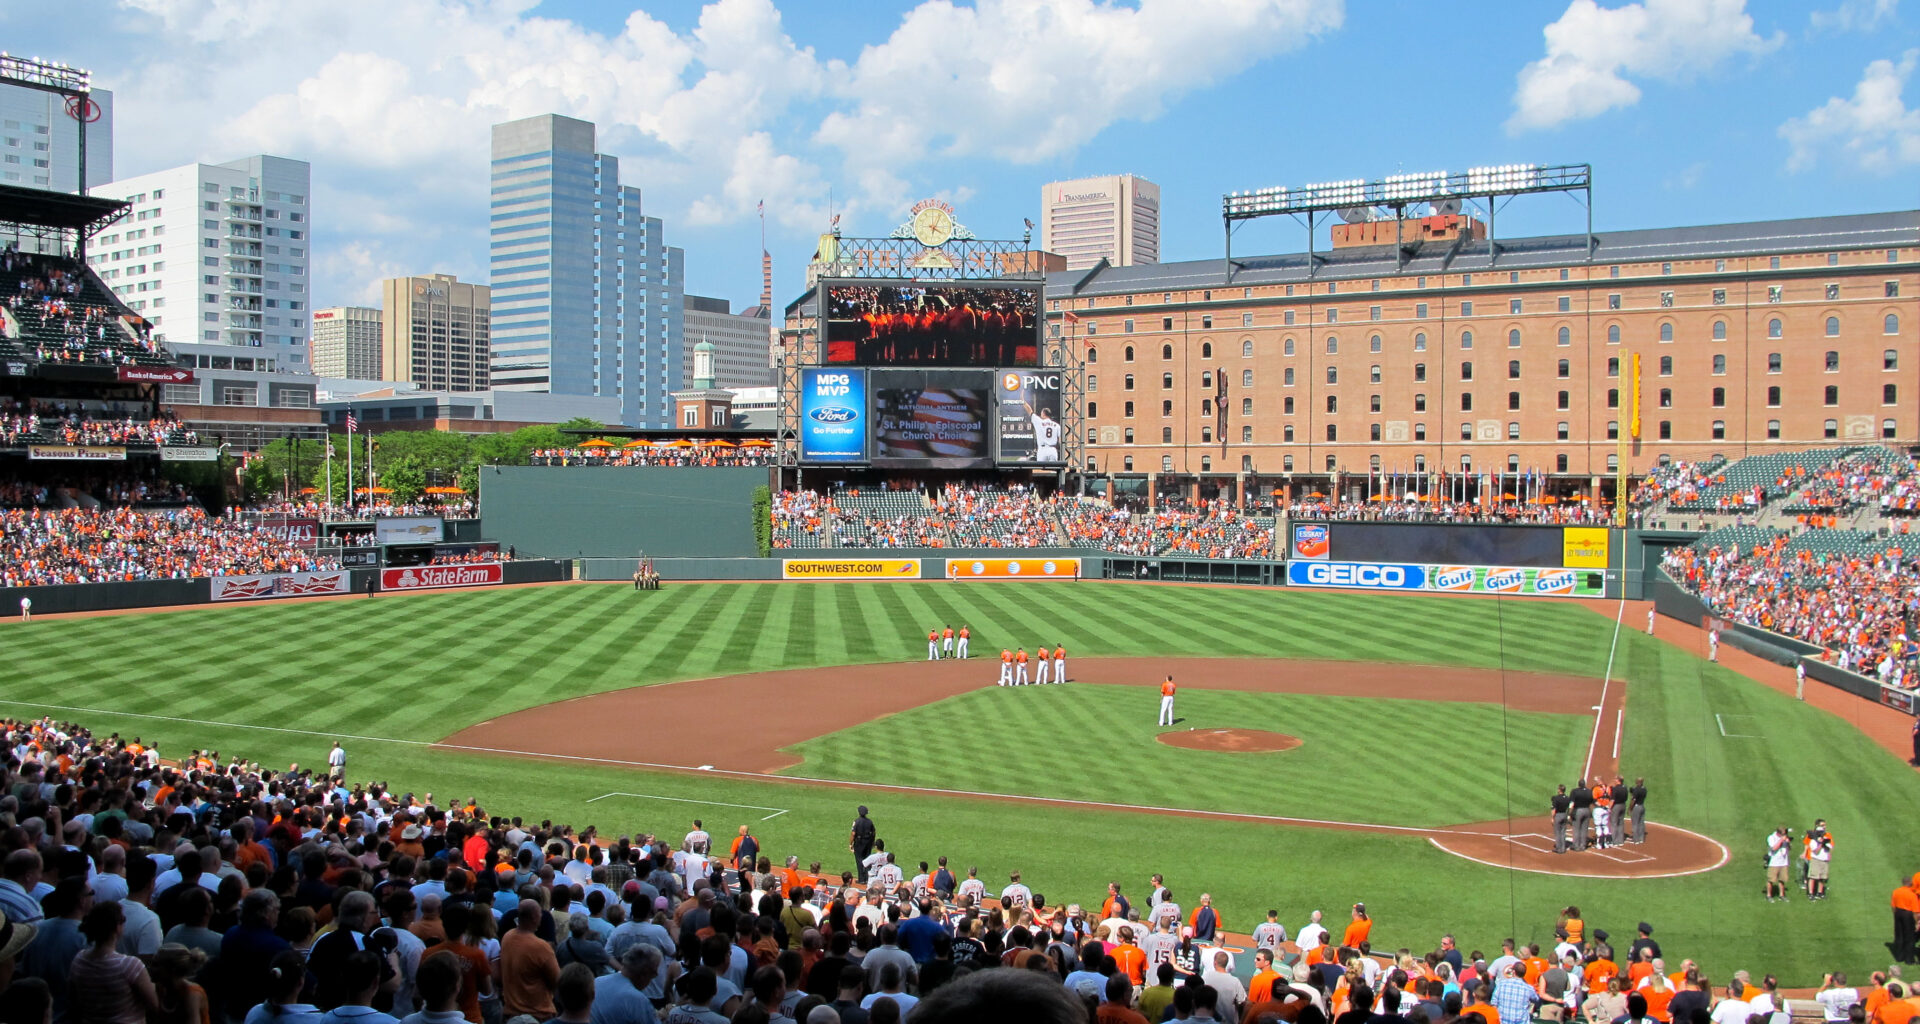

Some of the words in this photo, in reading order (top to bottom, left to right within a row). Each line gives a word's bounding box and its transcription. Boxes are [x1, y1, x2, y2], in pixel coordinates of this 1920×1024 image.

[1064, 192, 1107, 202] TRANSAMERICA
[854, 250, 899, 268] THE
[426, 287, 444, 297] PNC
[127, 371, 142, 379] Bank
[149, 372, 173, 380] America
[817, 374, 850, 385] MPG
[1022, 375, 1060, 390] PNC
[817, 385, 850, 396] MVP
[817, 407, 850, 421] Ford
[883, 421, 897, 430] St.
[899, 421, 933, 432] Philip'
[935, 421, 981, 432] Episcopal
[902, 431, 935, 440] Church
[937, 431, 962, 440] Choir
[1046, 427, 1053, 439] 8
[33, 448, 76, 458] Seasons
[77, 448, 107, 459] Pizza
[1299, 530, 1324, 539] ESSKAY
[482, 551, 494, 559] utz
[788, 563, 883, 573] SOUTHWEST.COM
[1307, 563, 1406, 586] GEICO
[1438, 570, 1474, 587] Gulf
[1486, 571, 1522, 589] Gulf
[1536, 573, 1573, 590] Gulf
[883, 873, 894, 884] 13
[1011, 894, 1024, 905] 12
[1266, 934, 1275, 946] 4
[1154, 949, 1170, 964] 15
